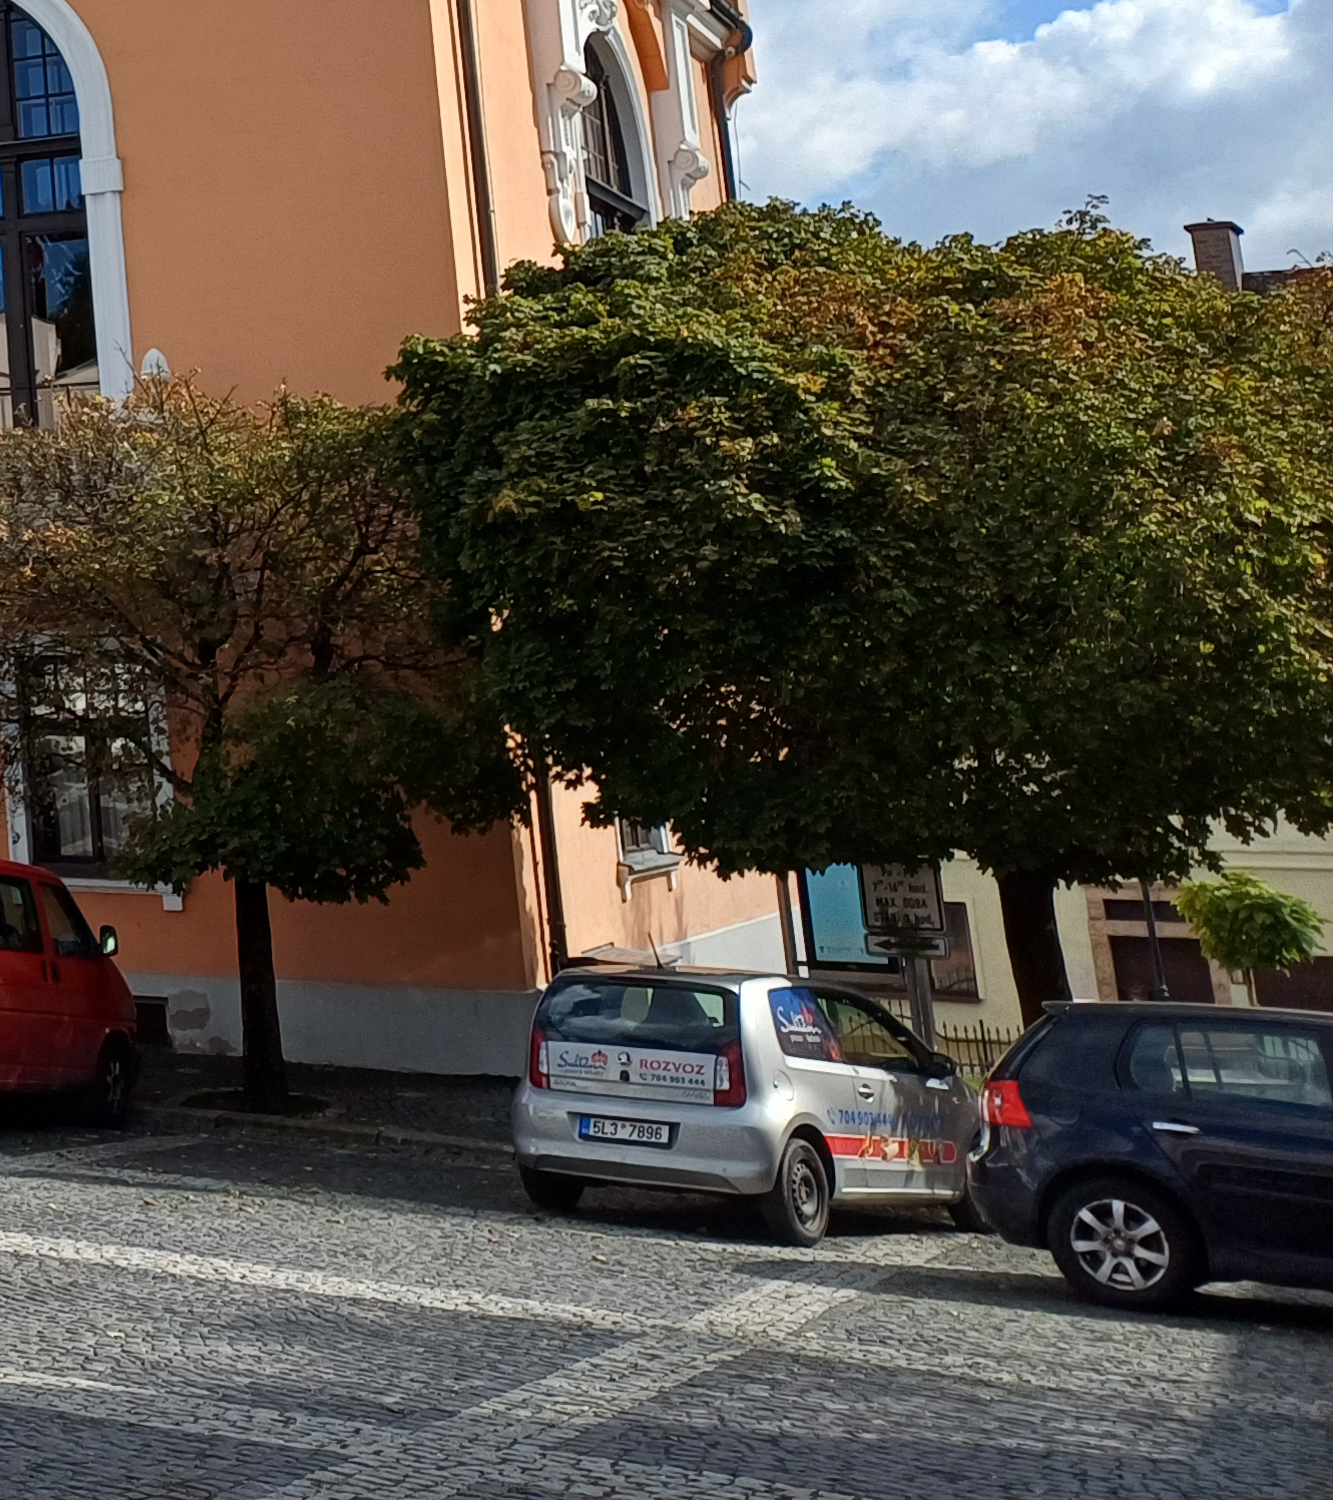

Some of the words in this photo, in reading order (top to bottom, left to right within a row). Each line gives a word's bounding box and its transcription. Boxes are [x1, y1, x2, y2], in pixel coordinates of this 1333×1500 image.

[639, 1058, 706, 1076] ROZVOZ
[838, 1109, 855, 1125] 704
[592, 1120, 619, 1136] 5L3
[627, 1124, 663, 1141] 7896
